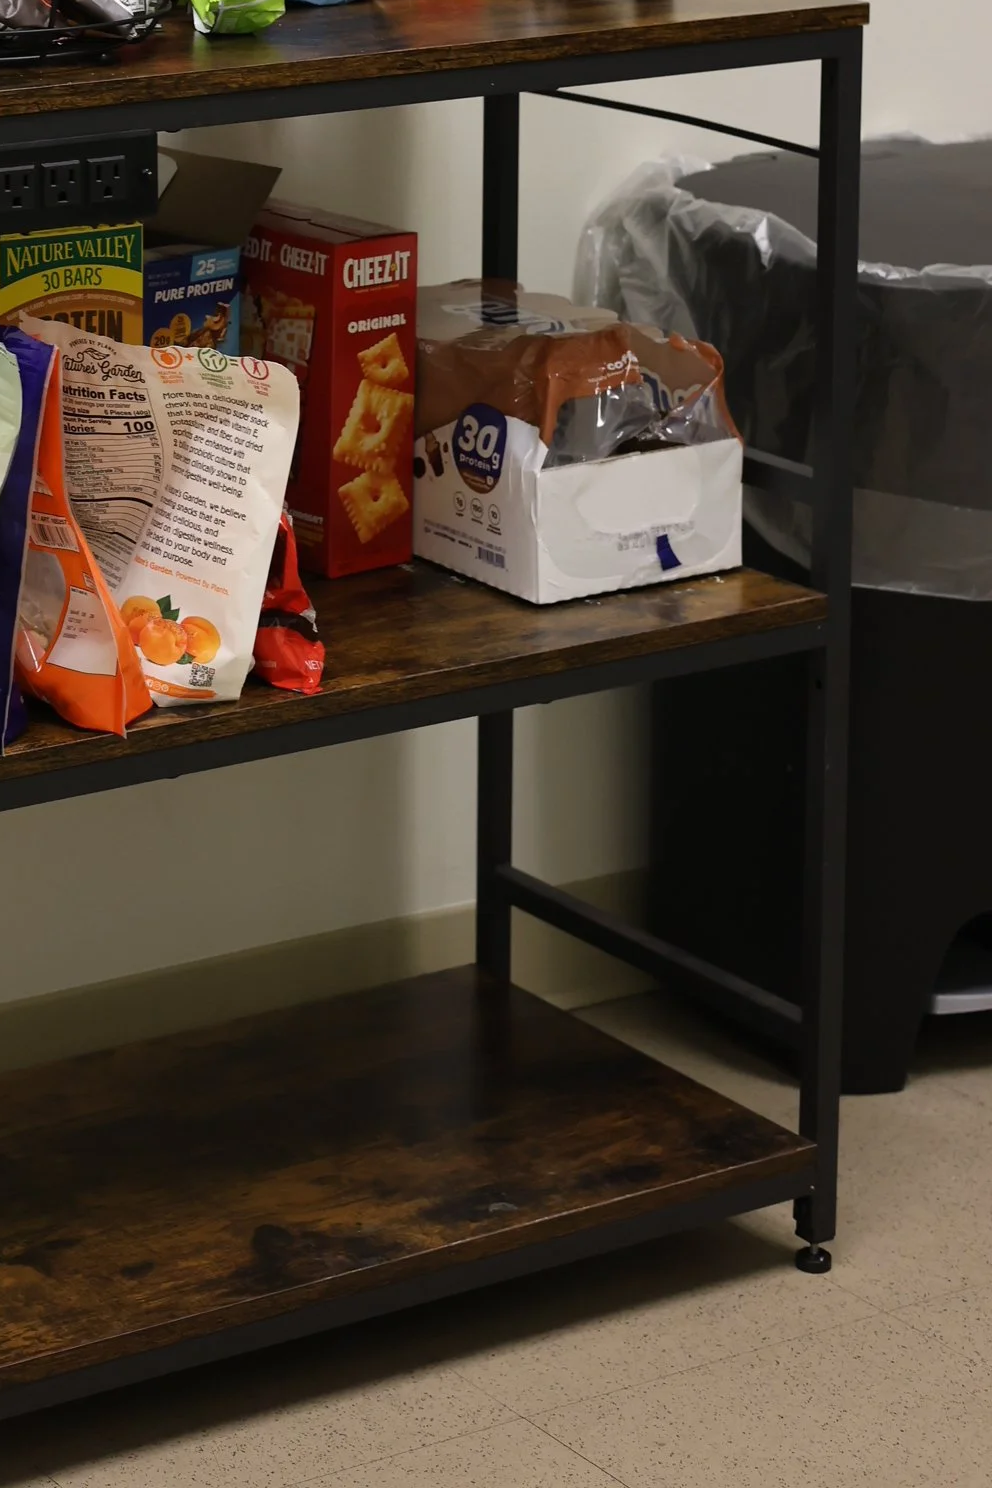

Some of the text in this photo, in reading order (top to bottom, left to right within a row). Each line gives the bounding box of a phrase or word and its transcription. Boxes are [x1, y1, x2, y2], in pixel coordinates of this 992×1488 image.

[6, 234, 136, 277] NATURE VALLEY
[195, 258, 216, 276] 25
[42, 267, 103, 292] 30 BARS
[154, 286, 186, 304] PURE
[187, 278, 234, 298] PROTEIN
[97, 361, 146, 384] Garden
[63, 385, 146, 401] utrition Facts
[163, 392, 184, 400] More
[185, 392, 203, 400] than
[212, 394, 249, 409] deliciously
[165, 401, 270, 429] chewy, and plump super snack
[168, 410, 184, 418] that
[123, 421, 154, 433] 100
[205, 439, 234, 455] enhanced
[234, 436, 245, 445] our
[245, 440, 264, 453] dried
[237, 462, 251, 474] that
[459, 453, 492, 472] protein
[216, 469, 237, 482] shown
[238, 475, 247, 486] to
[199, 510, 213, 523] that
[214, 517, 226, 527] are
[220, 507, 247, 522] believe
[173, 527, 202, 545] digestive
[204, 526, 219, 537] and
[163, 551, 194, 567] purpose.
[165, 538, 227, 566] to your body and
[305, 659, 321, 671] NET
